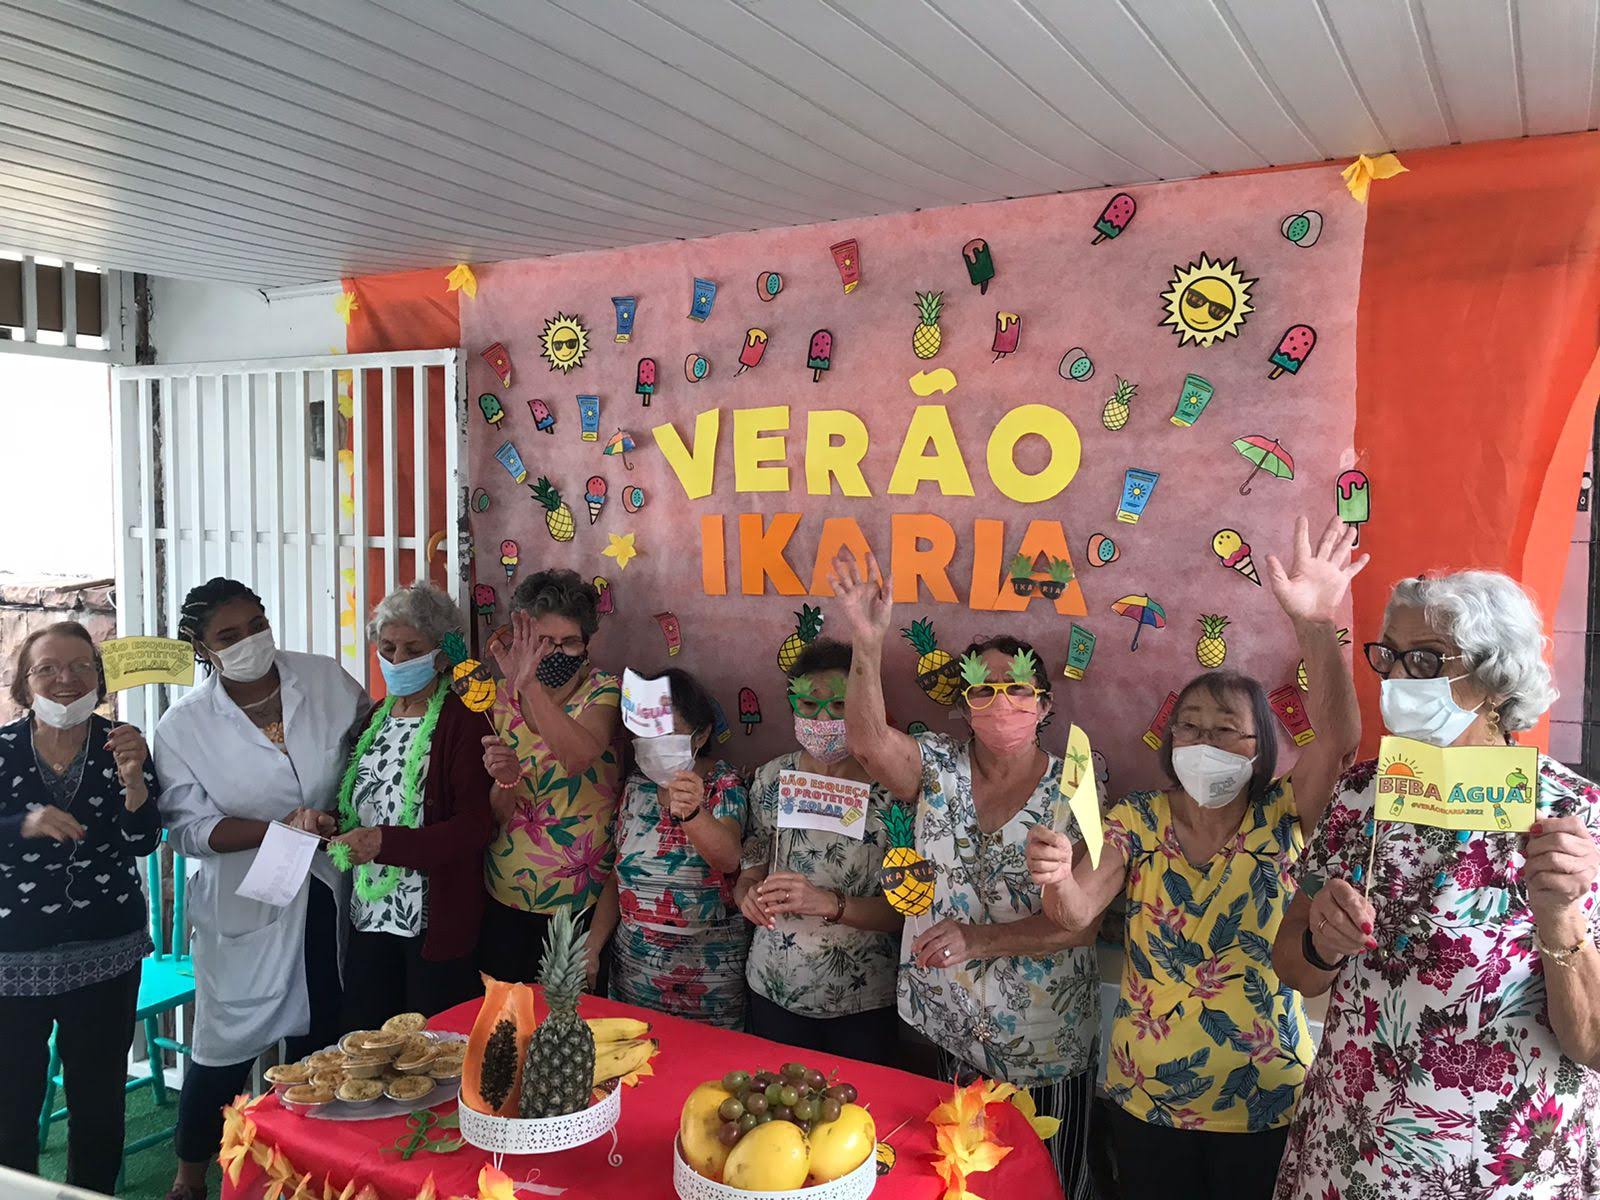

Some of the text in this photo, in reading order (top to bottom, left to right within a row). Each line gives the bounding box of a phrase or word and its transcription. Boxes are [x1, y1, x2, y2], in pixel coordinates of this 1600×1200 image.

[651, 367, 1082, 503] VERÃO
[701, 513, 1088, 617] IKARIA
[781, 787, 863, 808] O PROTETOR
[810, 779, 869, 798] ESQUEÇA
[1379, 777, 1532, 804] BEBA ÁGUA!
[799, 800, 843, 816] SOLAR
[881, 872, 902, 885] IKA
